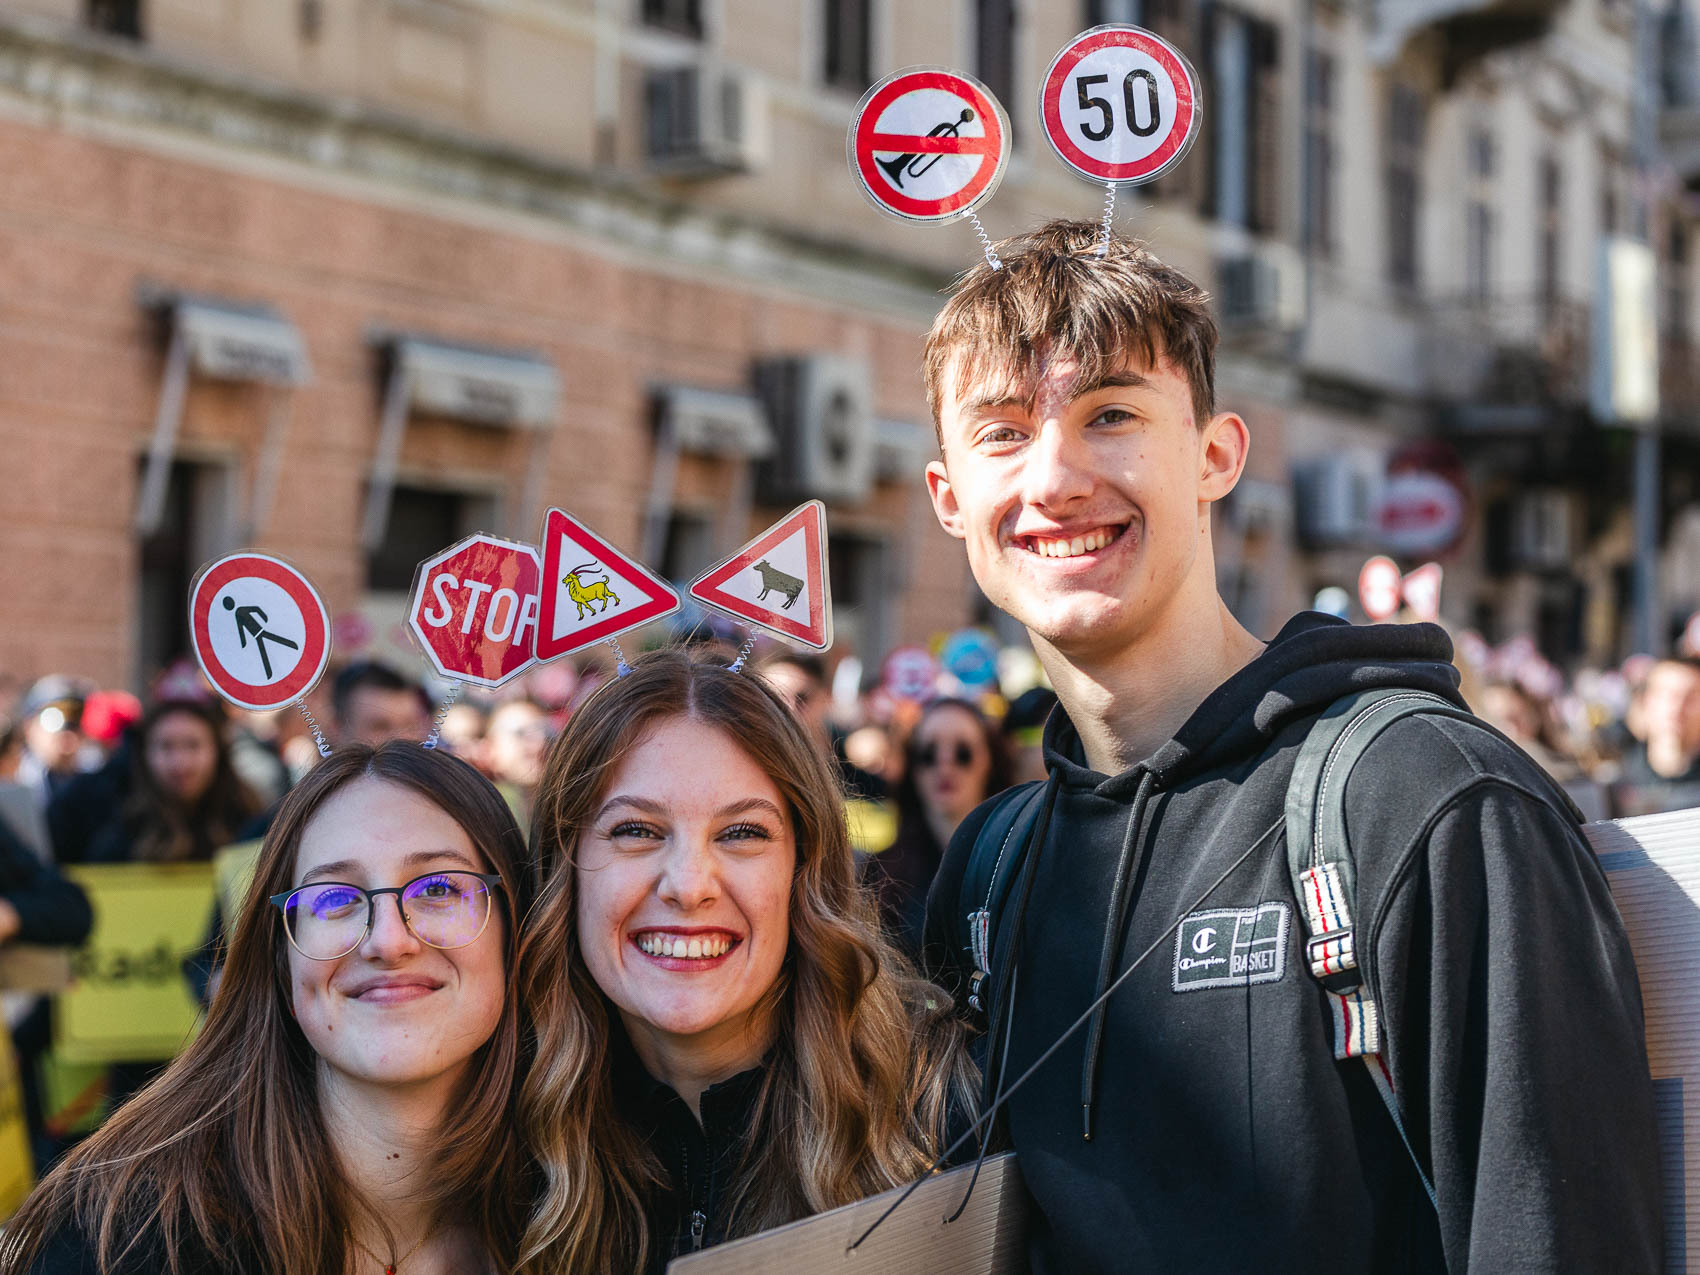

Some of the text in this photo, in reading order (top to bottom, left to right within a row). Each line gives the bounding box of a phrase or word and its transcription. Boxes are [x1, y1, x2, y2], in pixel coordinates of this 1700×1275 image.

[1076, 68, 1161, 142] 50
[1179, 956, 1227, 971] Champion
[1232, 949, 1276, 973] BASKET
